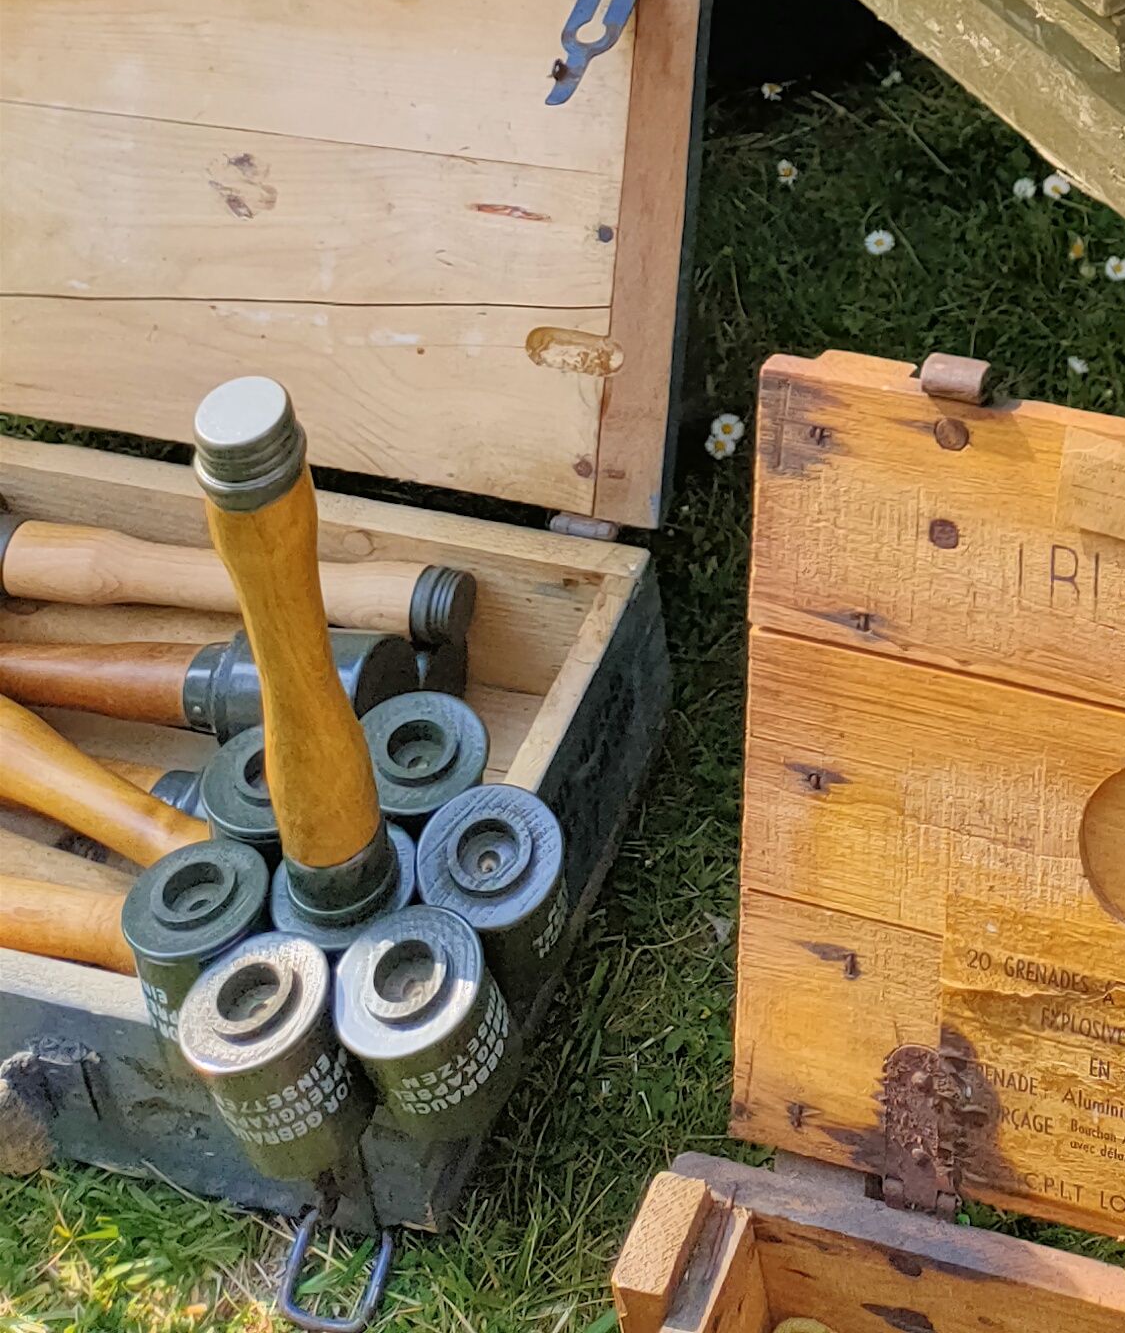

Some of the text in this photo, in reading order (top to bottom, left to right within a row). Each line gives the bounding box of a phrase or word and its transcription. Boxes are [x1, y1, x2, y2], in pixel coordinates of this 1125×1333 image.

[966, 948, 992, 972] 20
[1004, 955, 1089, 994] GRENADES
[978, 1064, 1040, 1096] RENADE
[1088, 1057, 1111, 1081] EN
[1000, 1105, 1054, 1136] RÇAGE
[1070, 1119, 1118, 1143] Bouchon
[1070, 1139, 1096, 1155] avec
